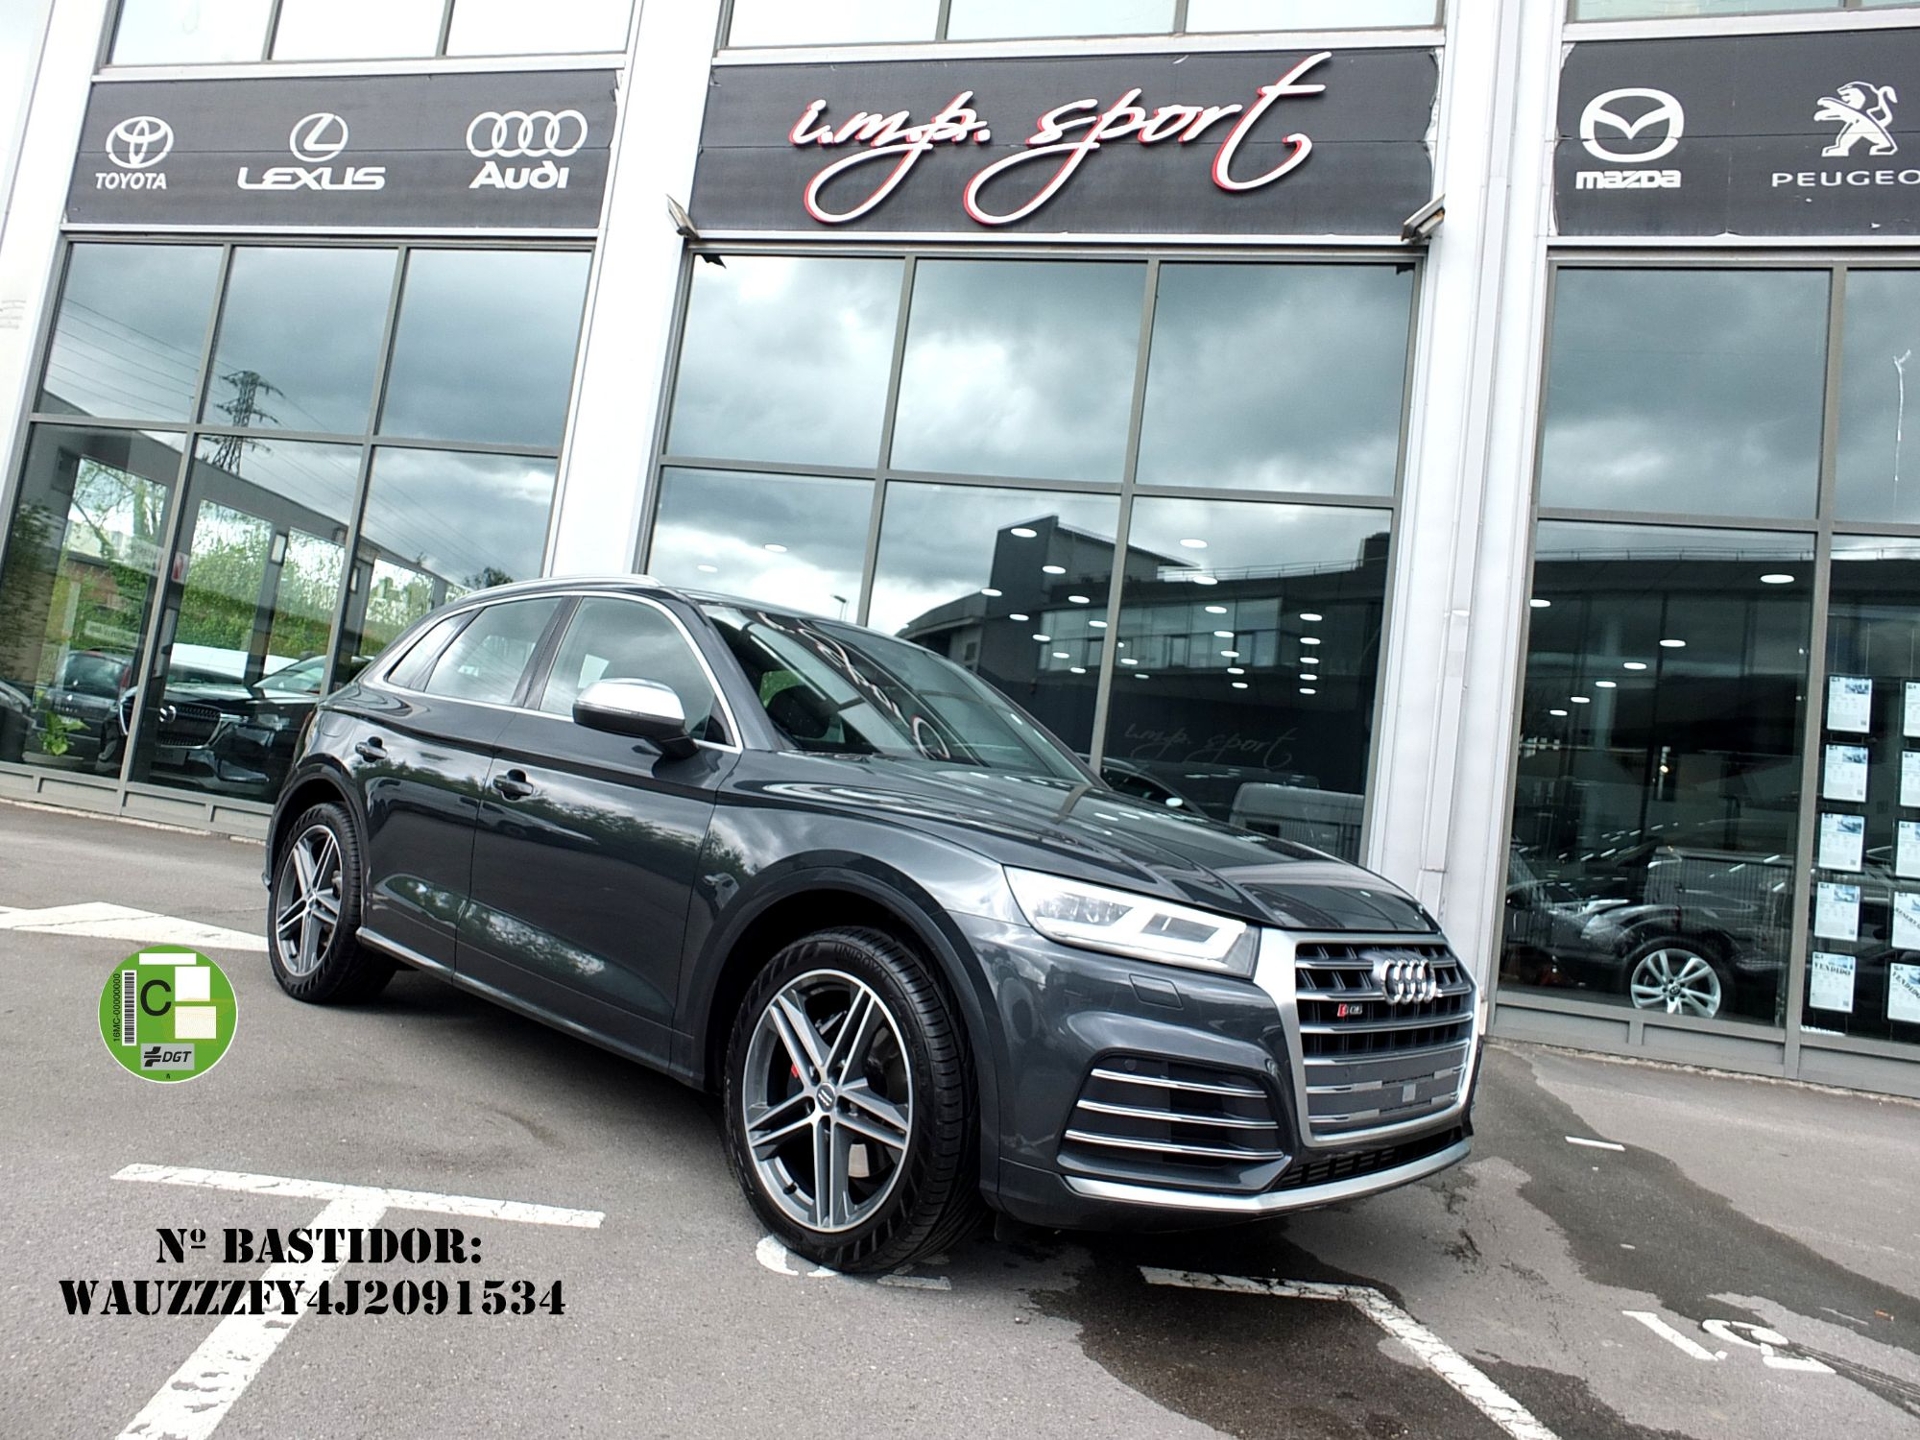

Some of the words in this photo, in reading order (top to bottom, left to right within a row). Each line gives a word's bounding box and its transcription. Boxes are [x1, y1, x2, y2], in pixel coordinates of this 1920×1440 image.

[963, 51, 1332, 224] sport
[95, 172, 167, 190] TOYOTA
[237, 167, 386, 190] LEXUS
[469, 160, 570, 189] Audi
[1575, 170, 1682, 190] mazda
[1771, 170, 1920, 187] PEUGEO
